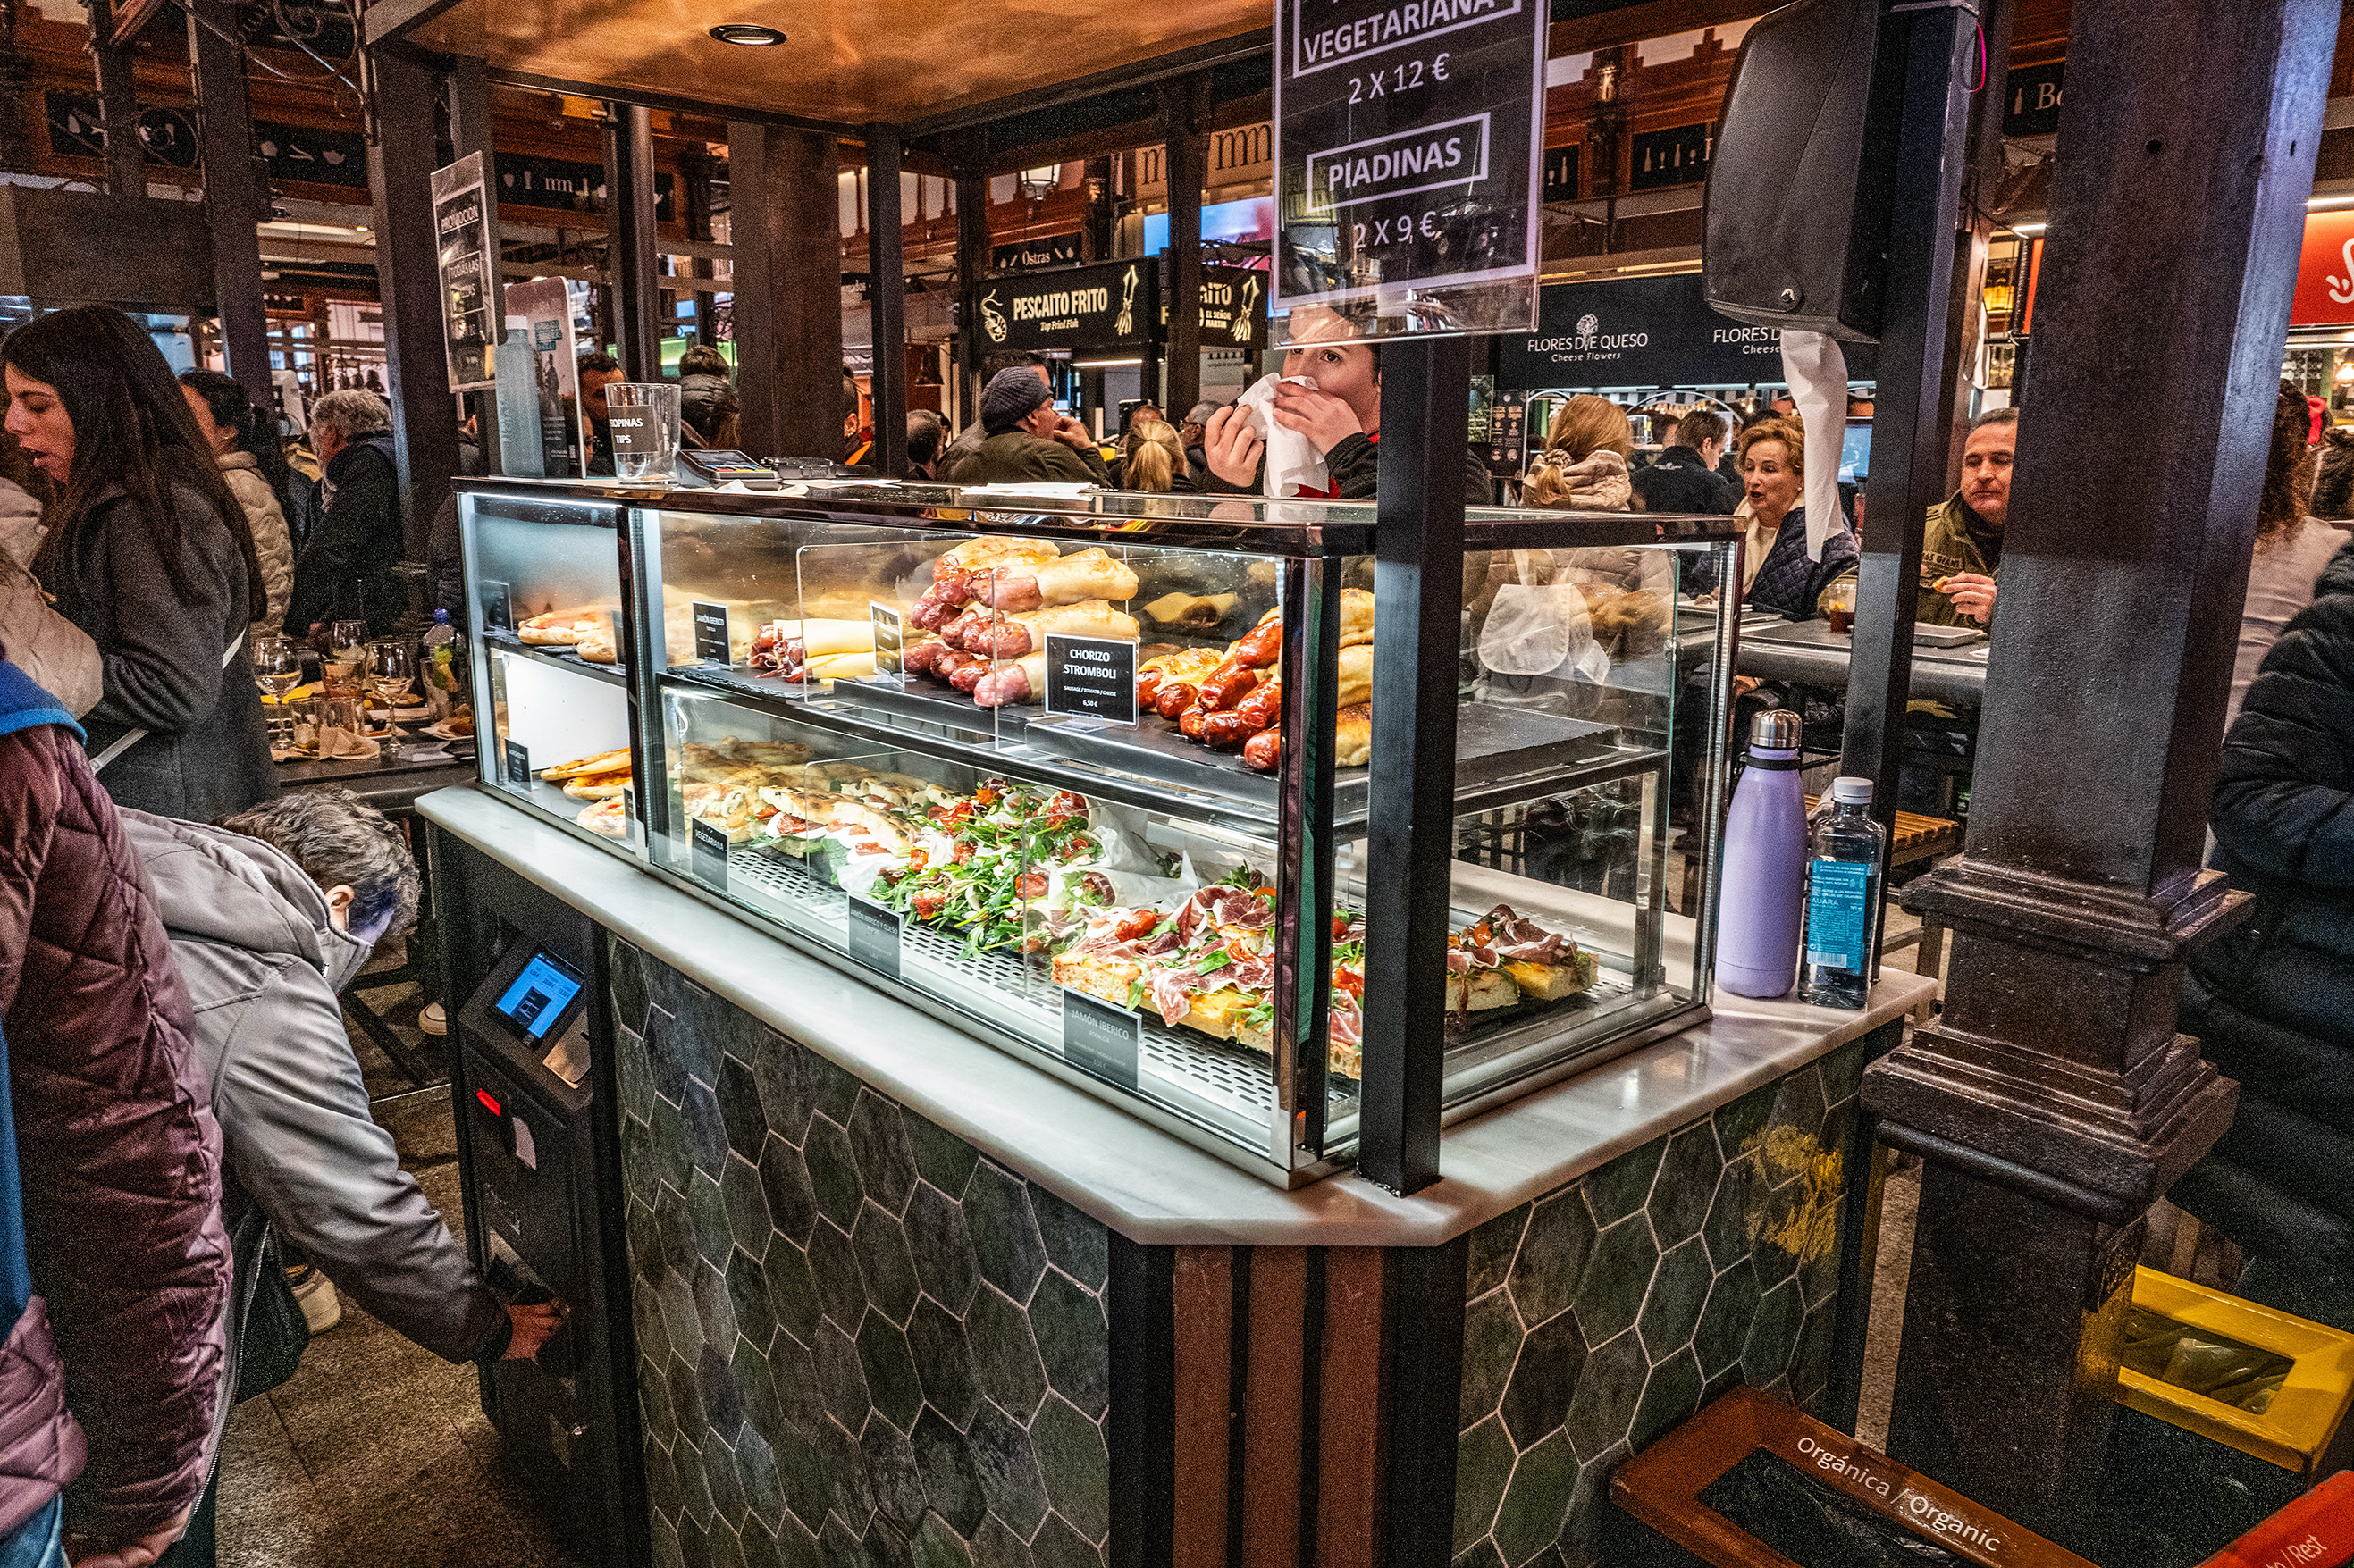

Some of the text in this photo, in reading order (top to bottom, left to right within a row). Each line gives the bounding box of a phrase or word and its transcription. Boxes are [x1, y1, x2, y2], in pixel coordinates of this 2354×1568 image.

[1348, 52, 1450, 105] 2 X 12 €
[1329, 137, 1462, 192] PIADINAS
[1353, 211, 1436, 249] 2 X 9 €
[1021, 250, 1051, 266] Ostras
[1013, 287, 1108, 320] PESCAITO FRITO
[1040, 318, 1079, 332] Top Fried Fish
[1527, 332, 1649, 352] FLORES DE QUESO
[1713, 327, 1769, 343] FLORES
[1551, 352, 1621, 363] Cheese Flowers
[1742, 345, 1781, 355] Cheese
[615, 434, 632, 444] TIPS
[1069, 649, 1110, 663] CHORIZO
[1063, 664, 1117, 680] STROMBOLI
[1072, 1009, 1130, 1040] JAMÓN IBERICO
[1797, 1437, 2001, 1552] Orgánica / Organic
[2287, 1533, 2328, 1564] Rest
